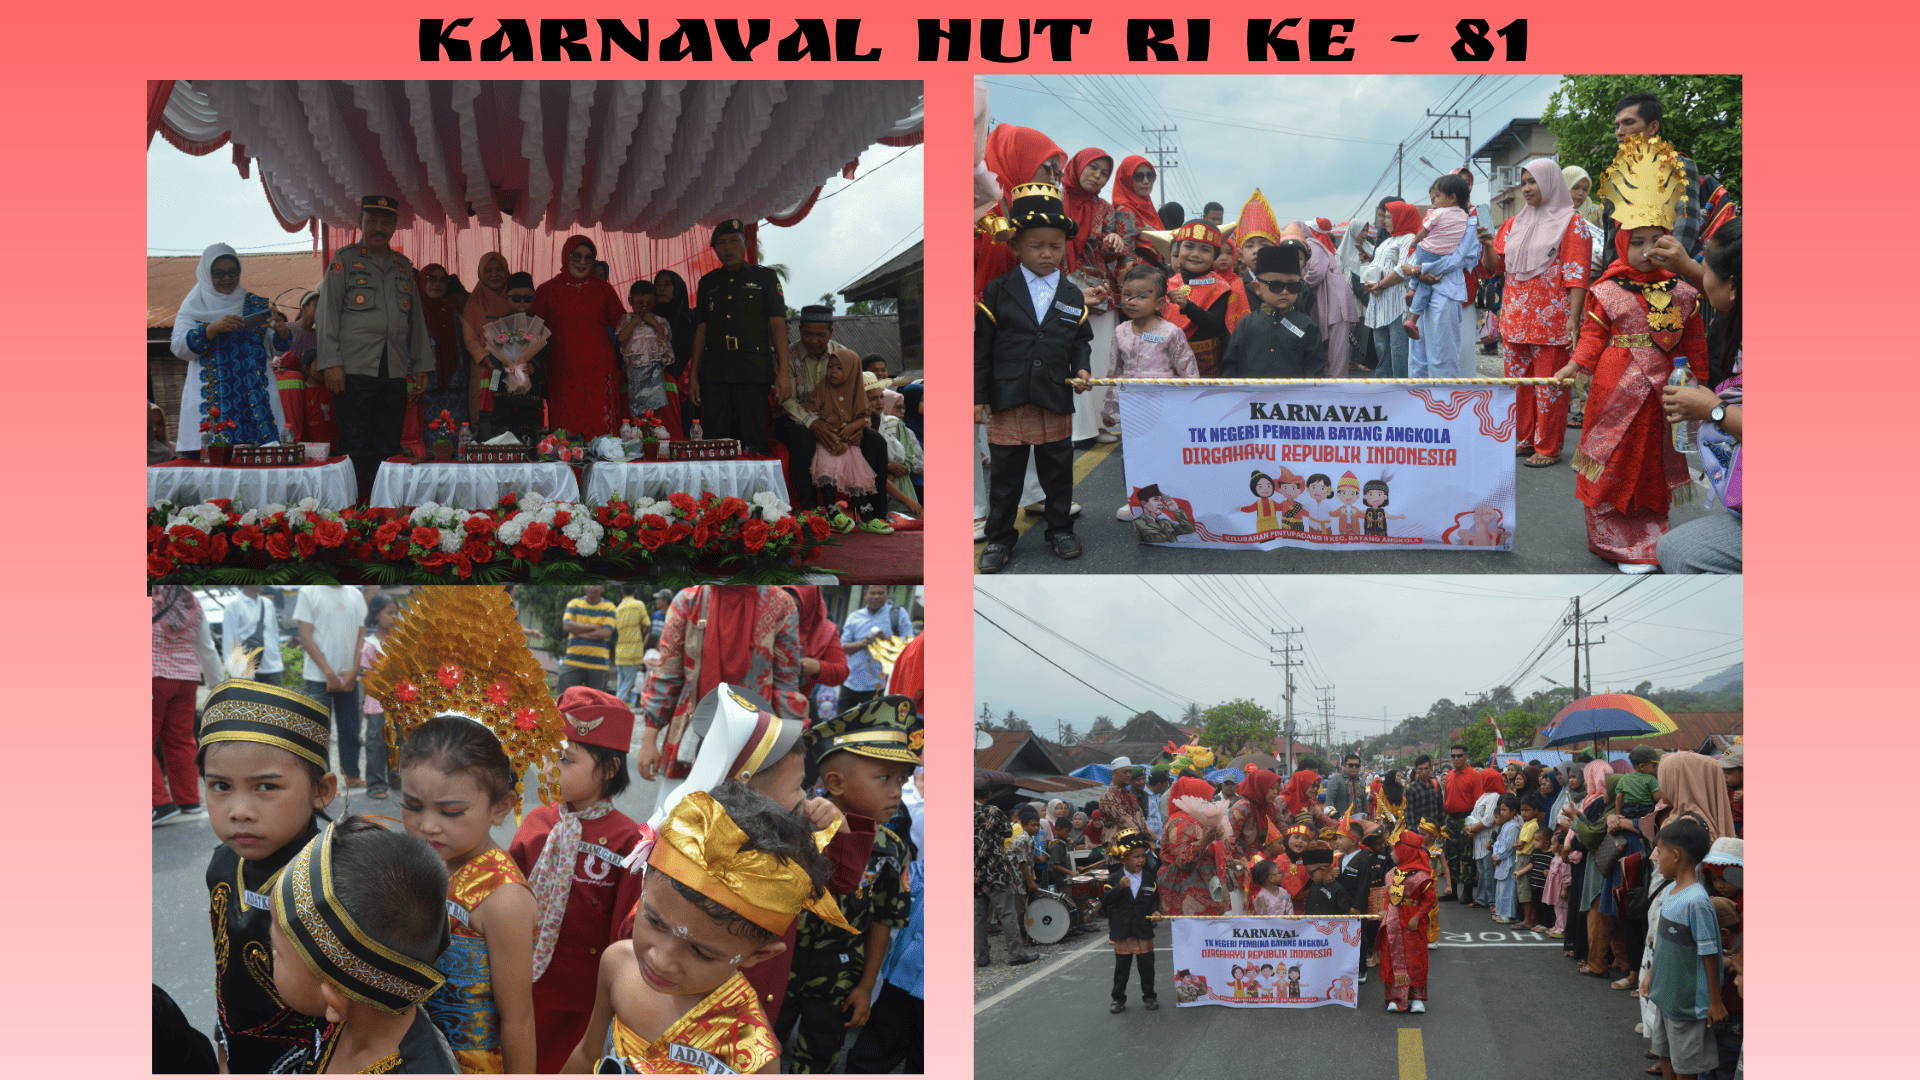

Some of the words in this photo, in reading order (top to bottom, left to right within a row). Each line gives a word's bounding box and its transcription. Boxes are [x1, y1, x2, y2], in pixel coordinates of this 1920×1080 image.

[1249, 402, 1388, 422] KARNAVAL
[1188, 427, 1208, 443] TK
[1210, 424, 1260, 443] NEGERI
[1262, 424, 1326, 441] PEMBINA
[1328, 426, 1383, 442] BATANG
[1385, 426, 1451, 444] ANGKOLA
[1182, 443, 1276, 465] DIRGAHAYU
[1281, 444, 1361, 464] REPUBLIK
[1366, 446, 1457, 467] INDONESIA
[1225, 533, 1269, 542] KELURAHAN
[1270, 530, 1321, 541] PINTUPADANG
[577, 842, 622, 865] PRAMUGARI
[1204, 939, 1214, 947] TK
[1215, 939, 1237, 947] NEGERI
[1238, 939, 1270, 948] PEMBINA
[1271, 939, 1297, 947] BATANG
[1298, 938, 1329, 947] ANGKOLA
[1232, 928, 1299, 938] KARNAVAL
[1201, 949, 1246, 959] DIRGAHAYU
[1247, 949, 1287, 959] REPUBLIK
[1289, 948, 1332, 959] INDONESIA
[674, 1046, 714, 1072] ADAT
